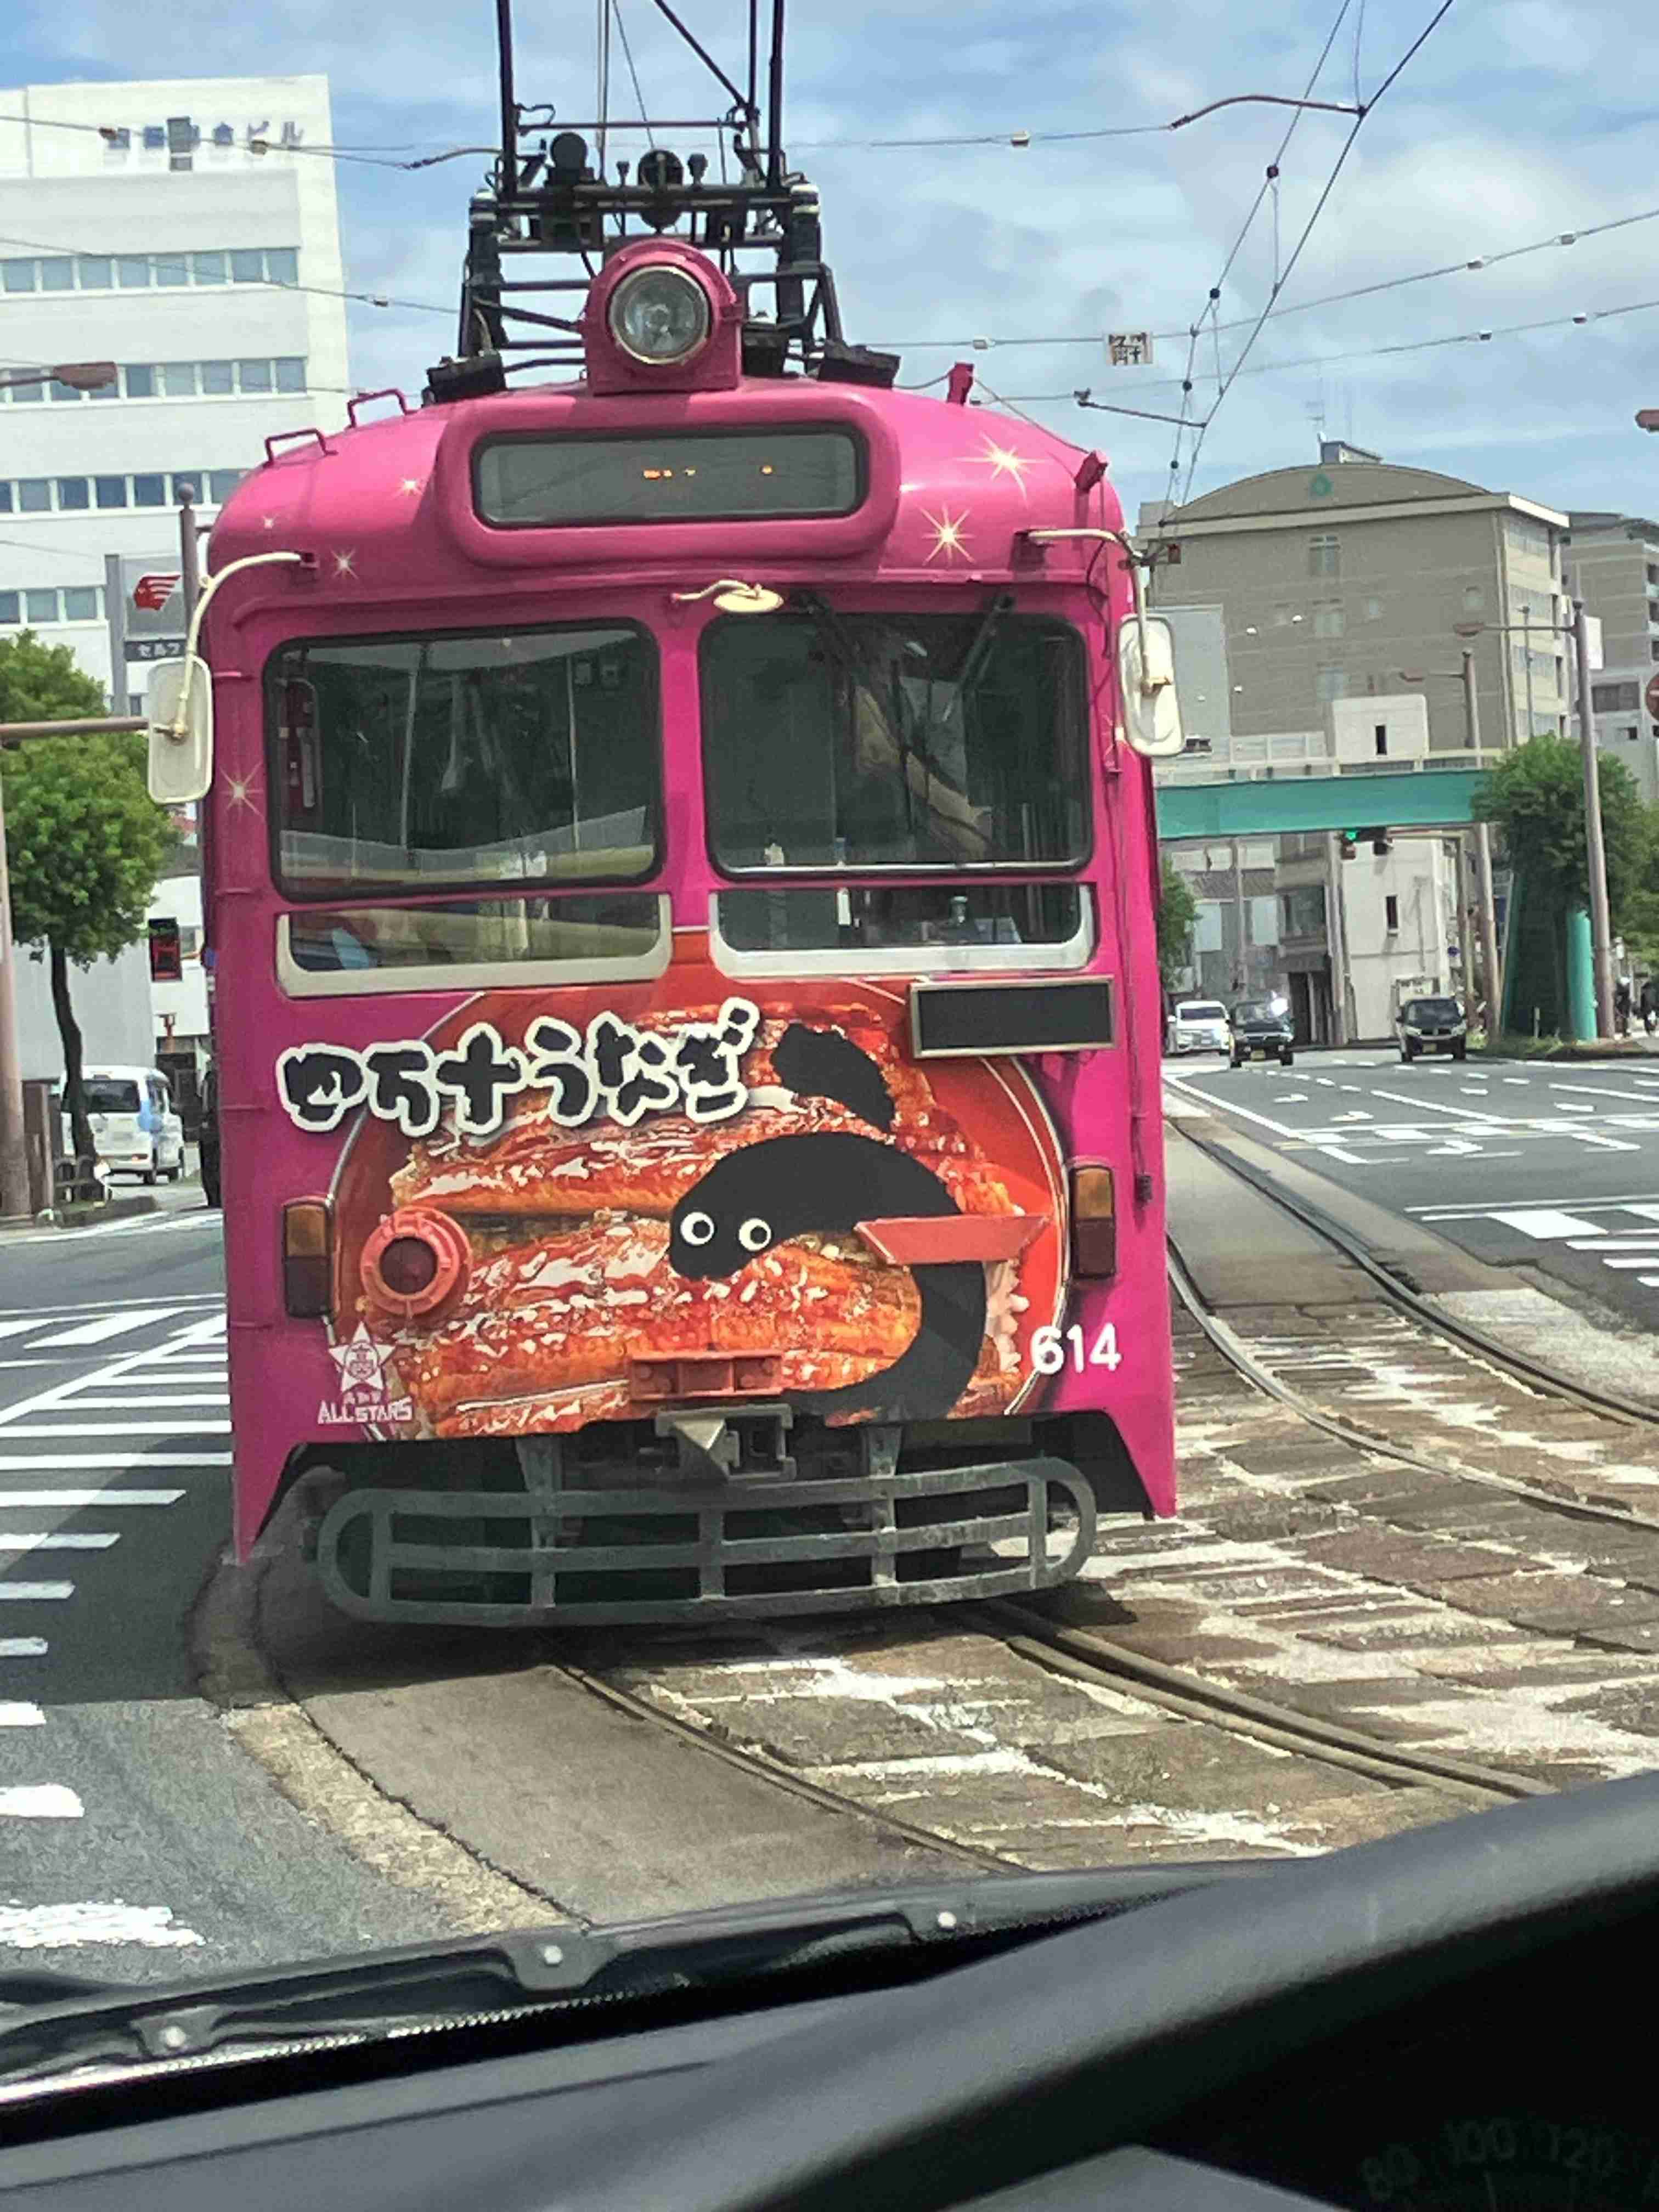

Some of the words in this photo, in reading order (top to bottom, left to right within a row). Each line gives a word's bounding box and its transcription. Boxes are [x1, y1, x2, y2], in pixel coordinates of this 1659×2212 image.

[276, 997, 759, 1137] 四万十うなぎ
[1030, 1323, 1122, 1374] 614
[1444, 2118, 1516, 2165] 100
[1546, 2123, 1616, 2176] 120
